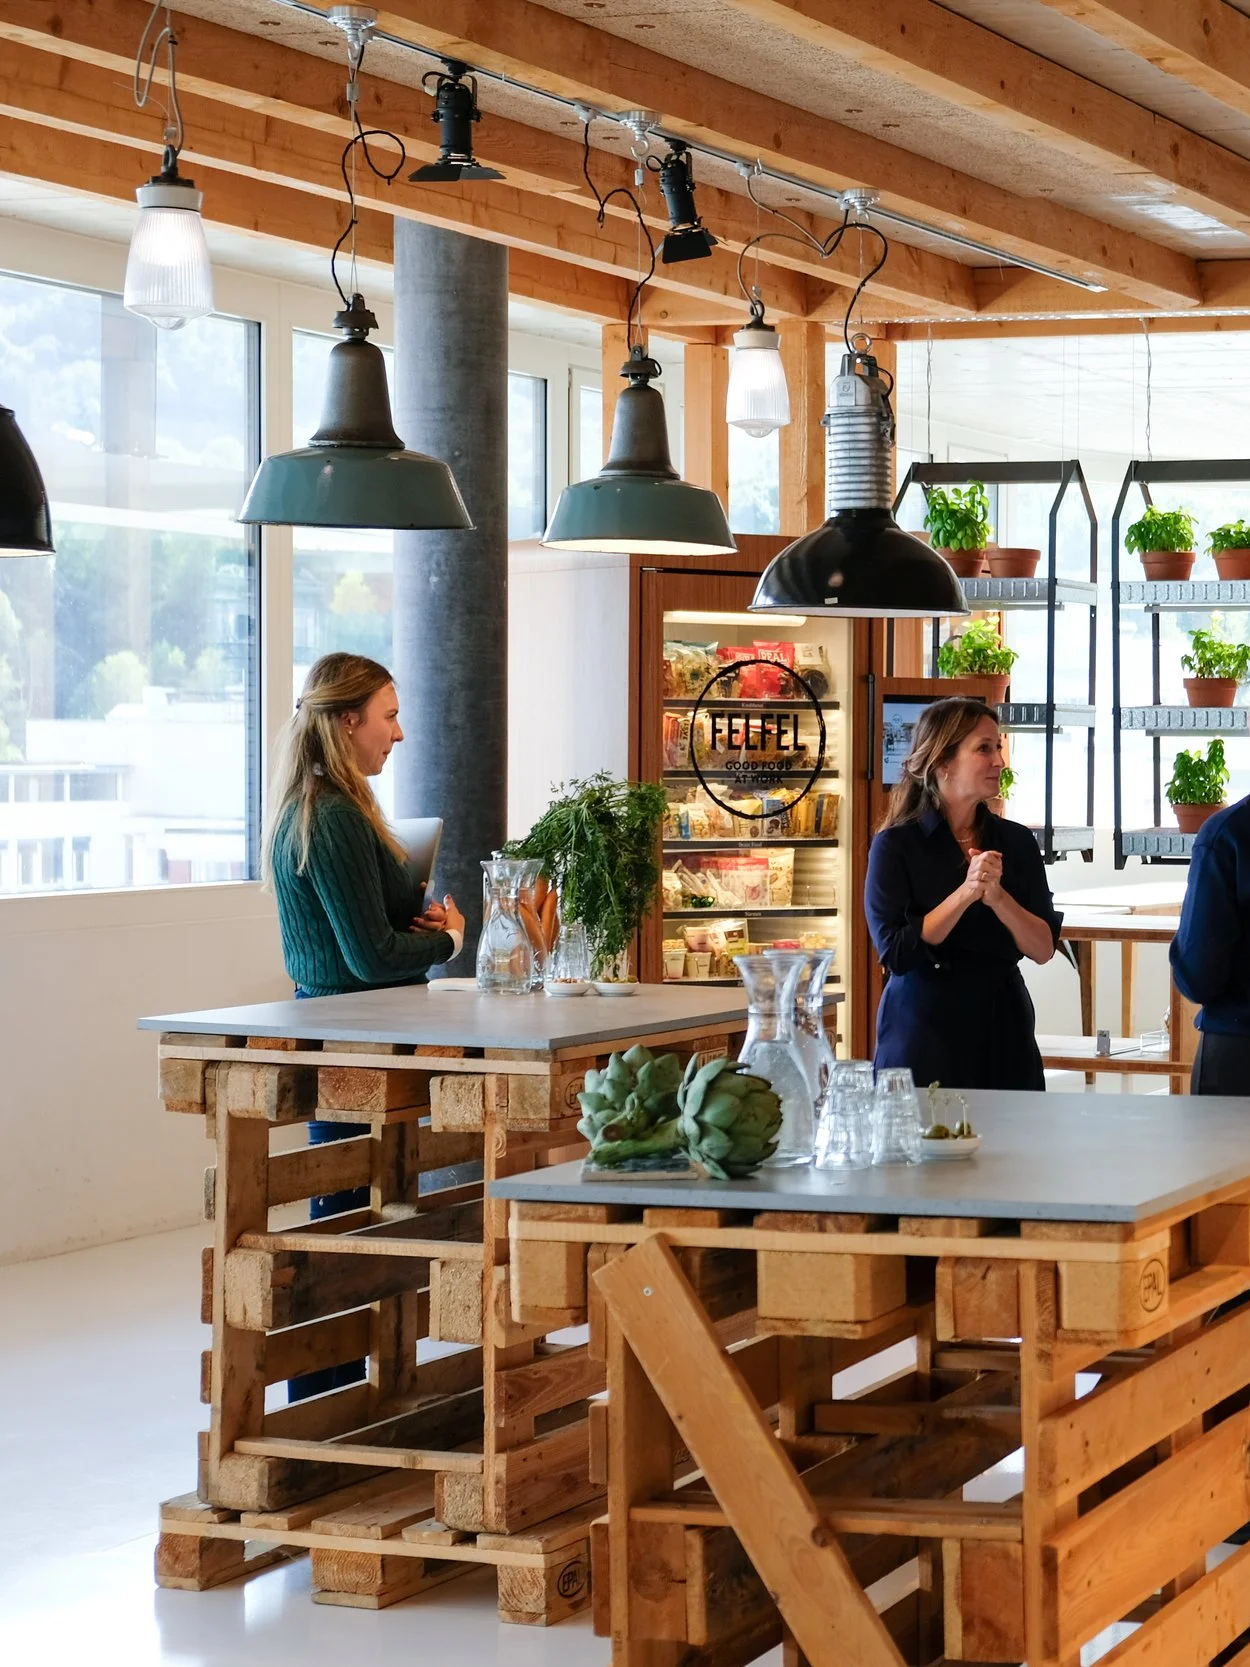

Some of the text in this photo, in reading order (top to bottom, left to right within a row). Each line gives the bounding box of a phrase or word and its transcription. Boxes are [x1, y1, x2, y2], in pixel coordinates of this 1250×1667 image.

[711, 713, 806, 751] FELFEL
[725, 761, 792, 770] GOOD FOOD
[735, 774, 748, 784] AT
[751, 774, 783, 784] WORK
